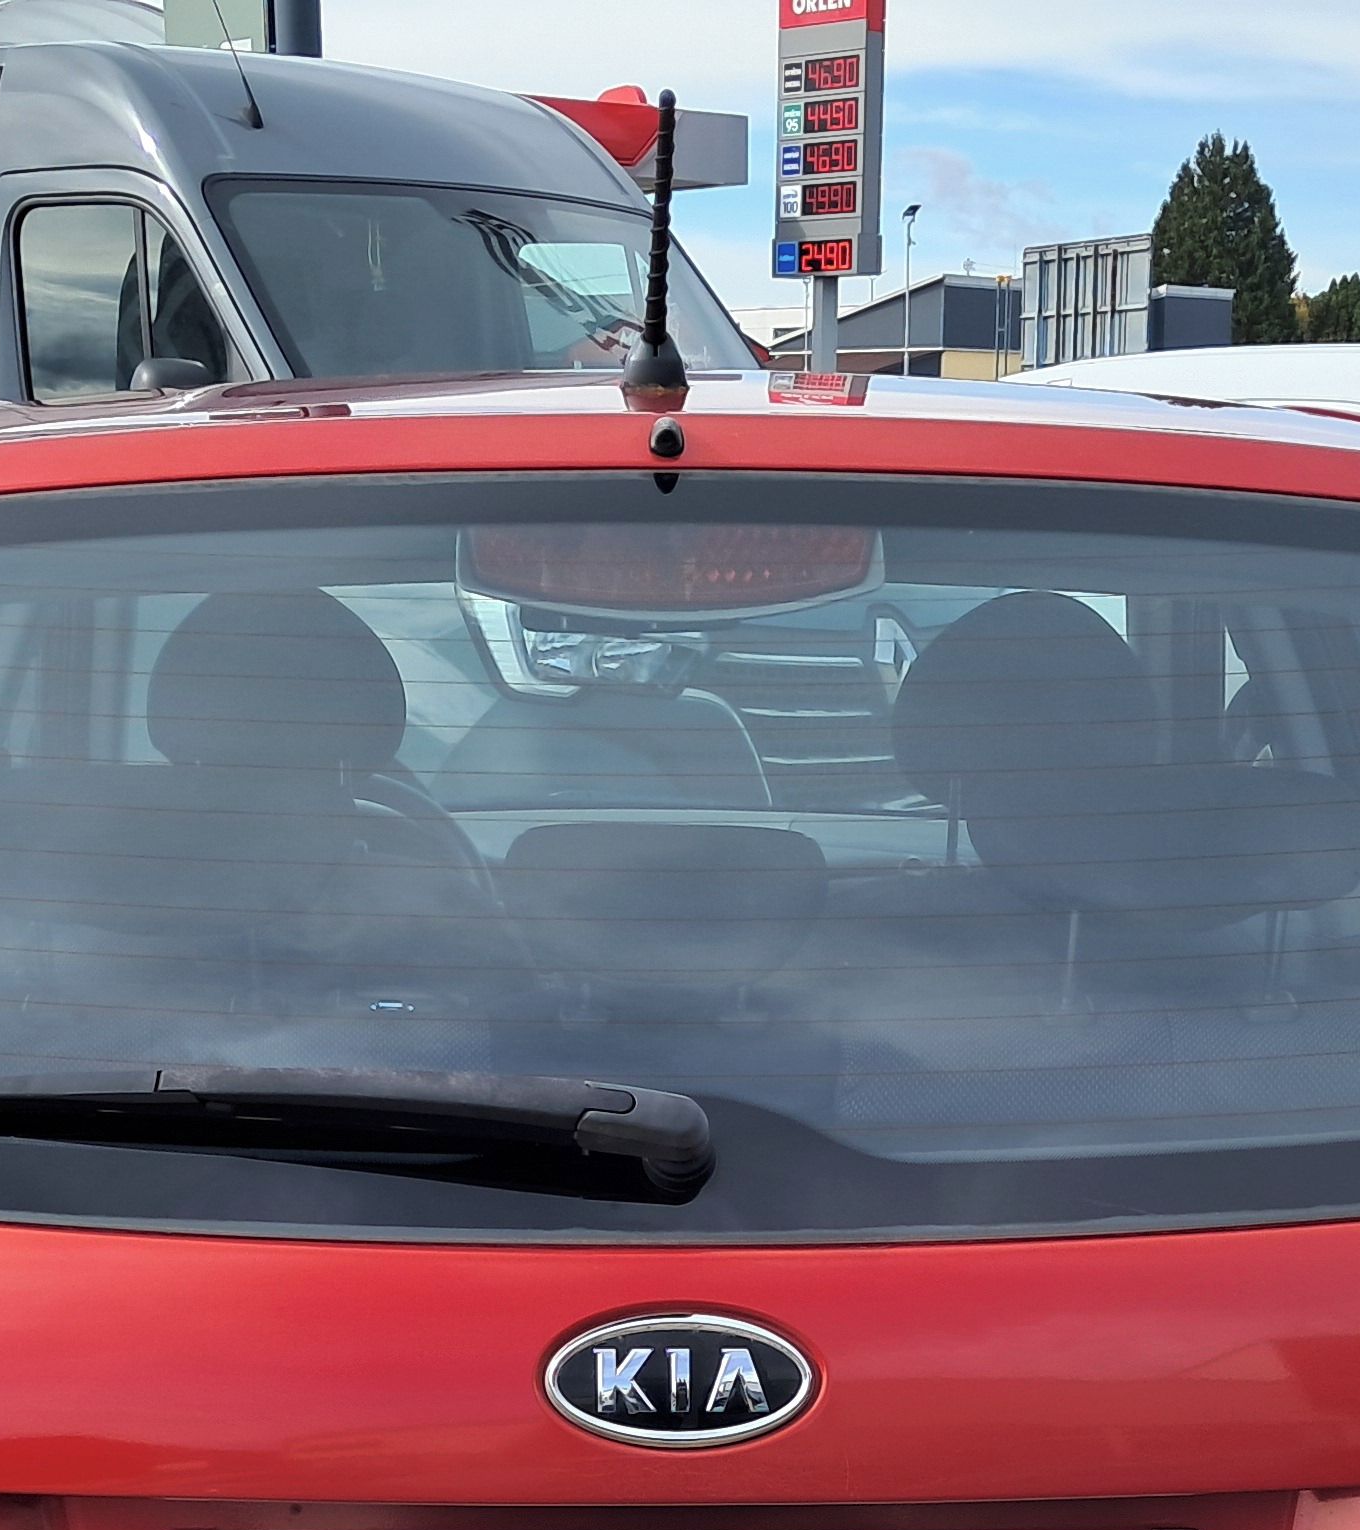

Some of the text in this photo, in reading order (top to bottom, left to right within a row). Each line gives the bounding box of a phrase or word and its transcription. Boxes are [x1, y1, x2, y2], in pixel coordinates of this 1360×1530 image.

[786, 118, 799, 133] 95
[783, 201, 798, 214] 100
[593, 1348, 770, 1413] KIA
